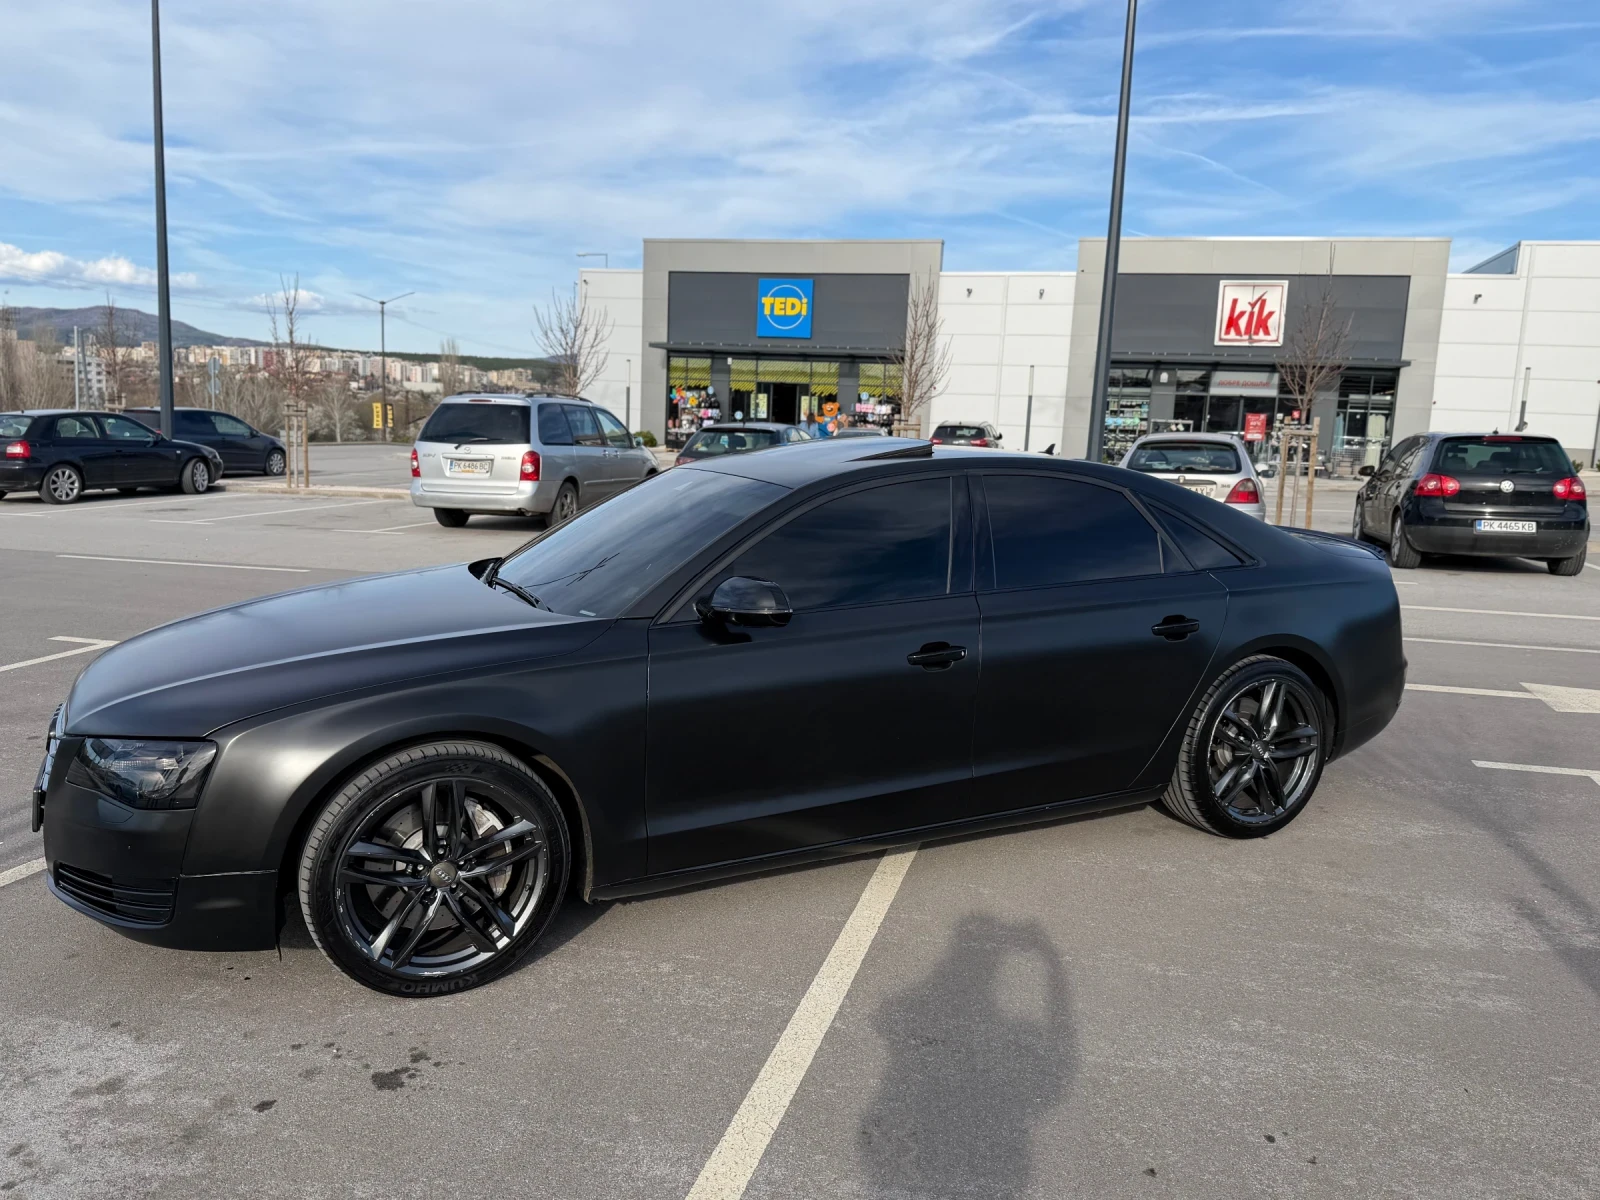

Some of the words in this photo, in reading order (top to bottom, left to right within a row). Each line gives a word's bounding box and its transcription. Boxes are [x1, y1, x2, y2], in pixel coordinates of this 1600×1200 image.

[762, 297, 808, 316] TEDi
[1224, 291, 1276, 337] kik
[454, 461, 462, 469] PK
[463, 461, 478, 470] 6486
[479, 461, 488, 470] BC
[1483, 521, 1495, 530] PK
[1497, 522, 1520, 531] 4465
[1521, 523, 1534, 532] KB
[401, 974, 479, 993] KUMHO
